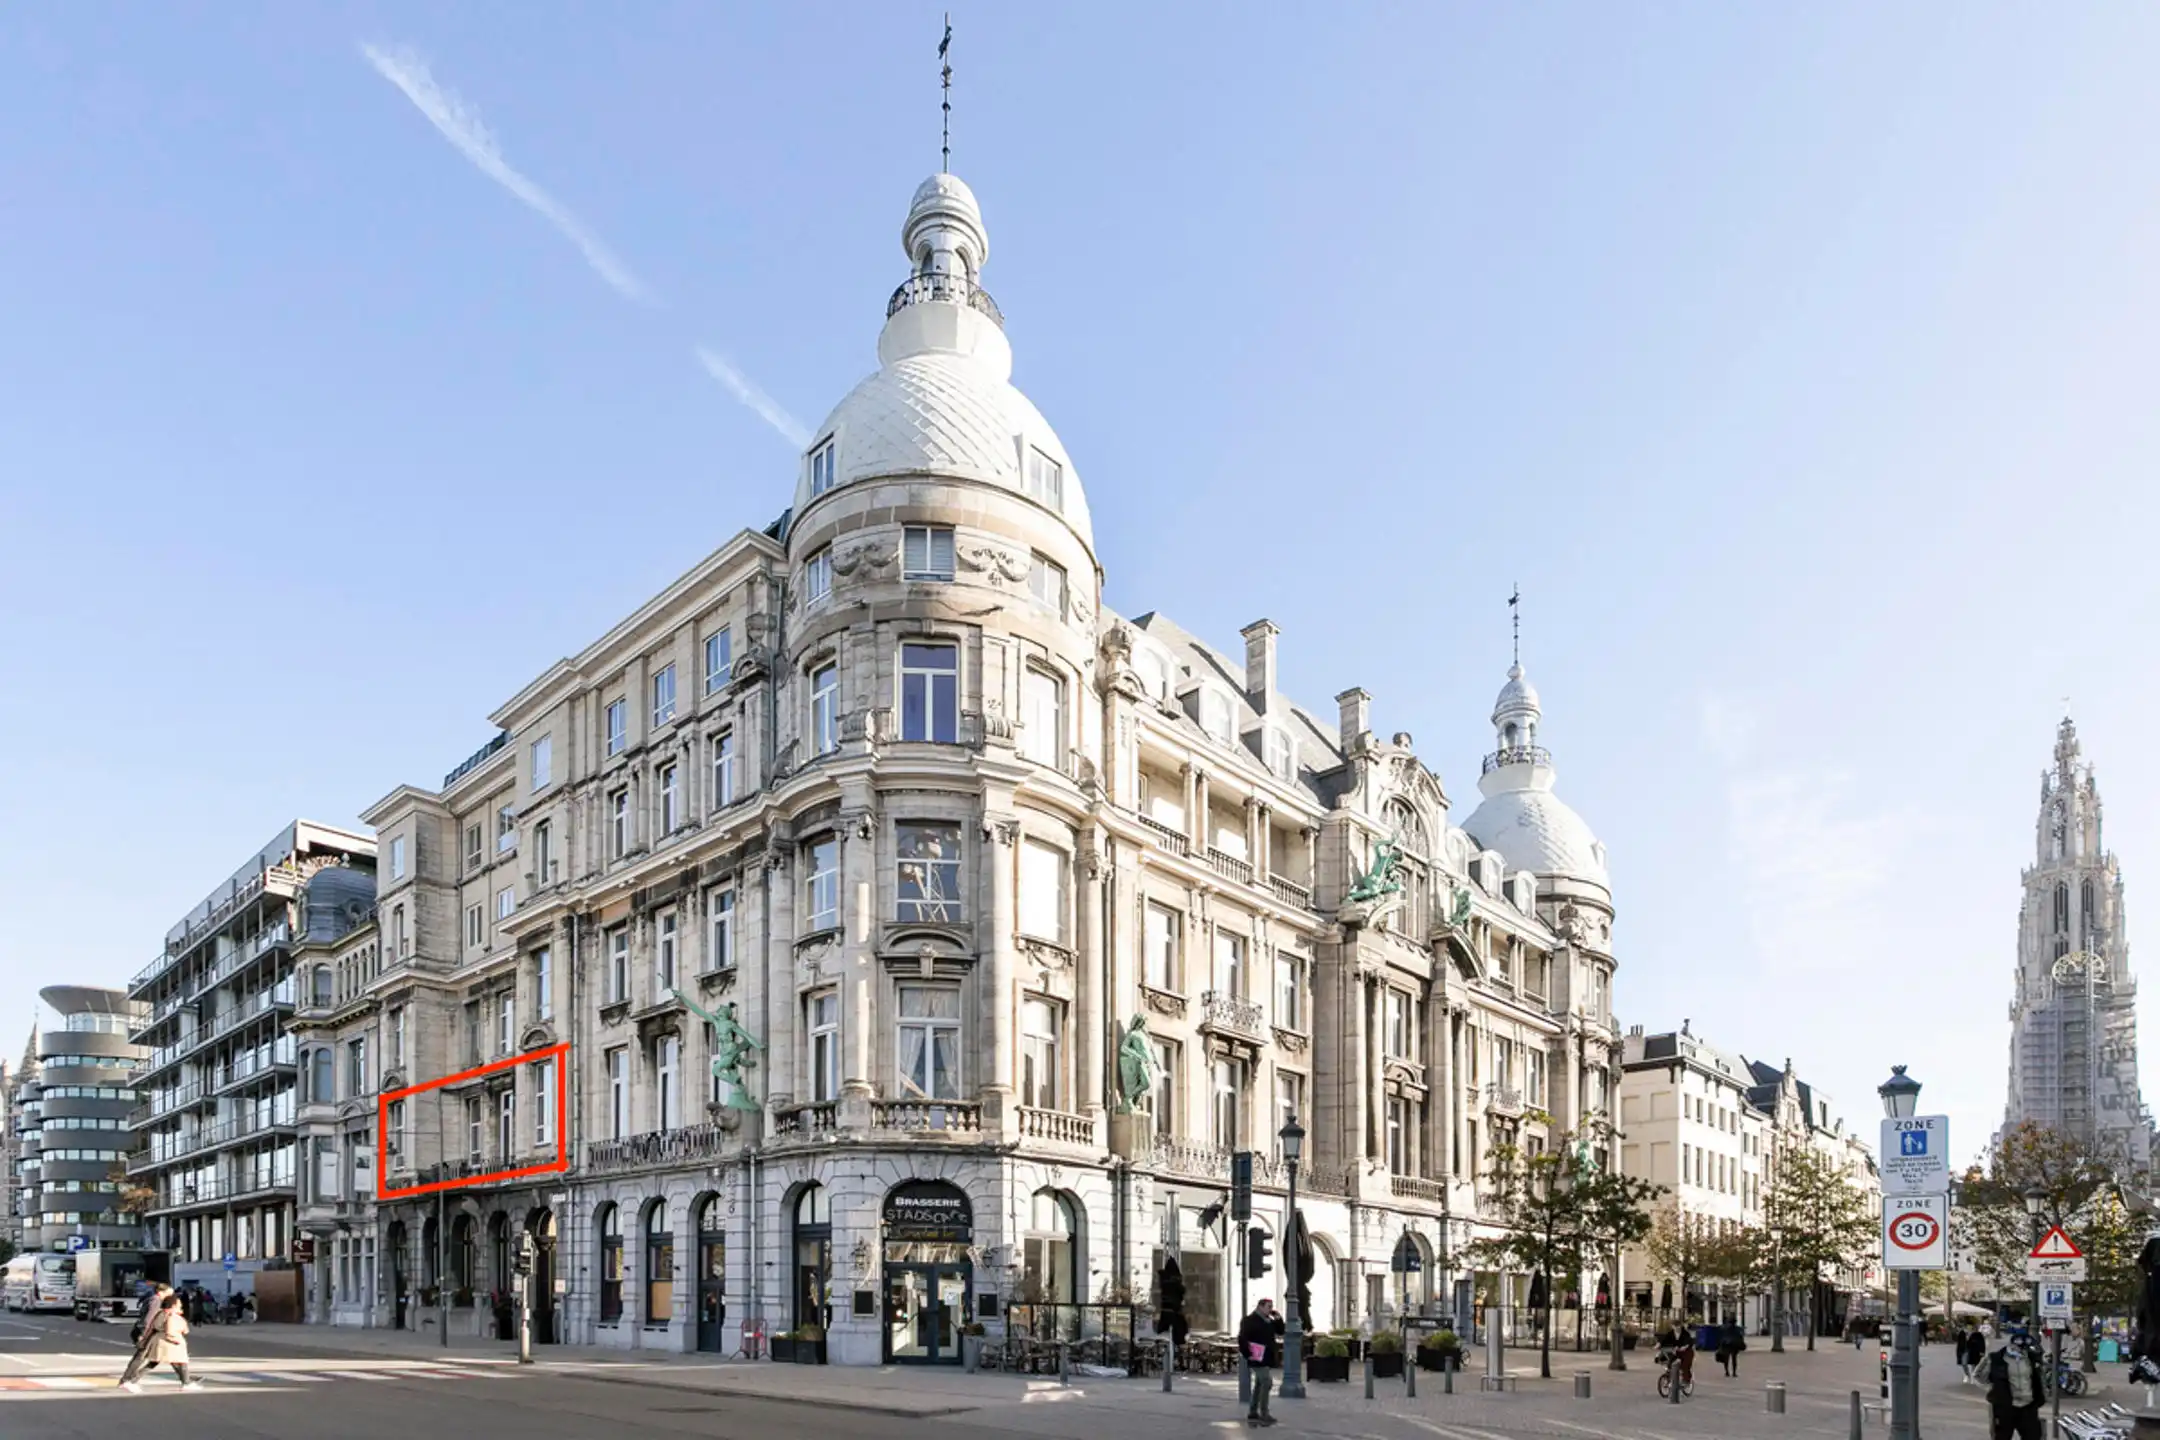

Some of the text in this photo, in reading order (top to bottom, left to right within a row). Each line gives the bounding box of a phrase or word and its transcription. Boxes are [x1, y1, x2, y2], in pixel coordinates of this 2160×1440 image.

[1894, 1119, 1935, 1131] ZONE
[895, 1196, 961, 1207] BRASSERIE
[1896, 1199, 1932, 1209] ZONE
[1901, 1223, 1927, 1238] 30
[68, 1236, 84, 1251] P
